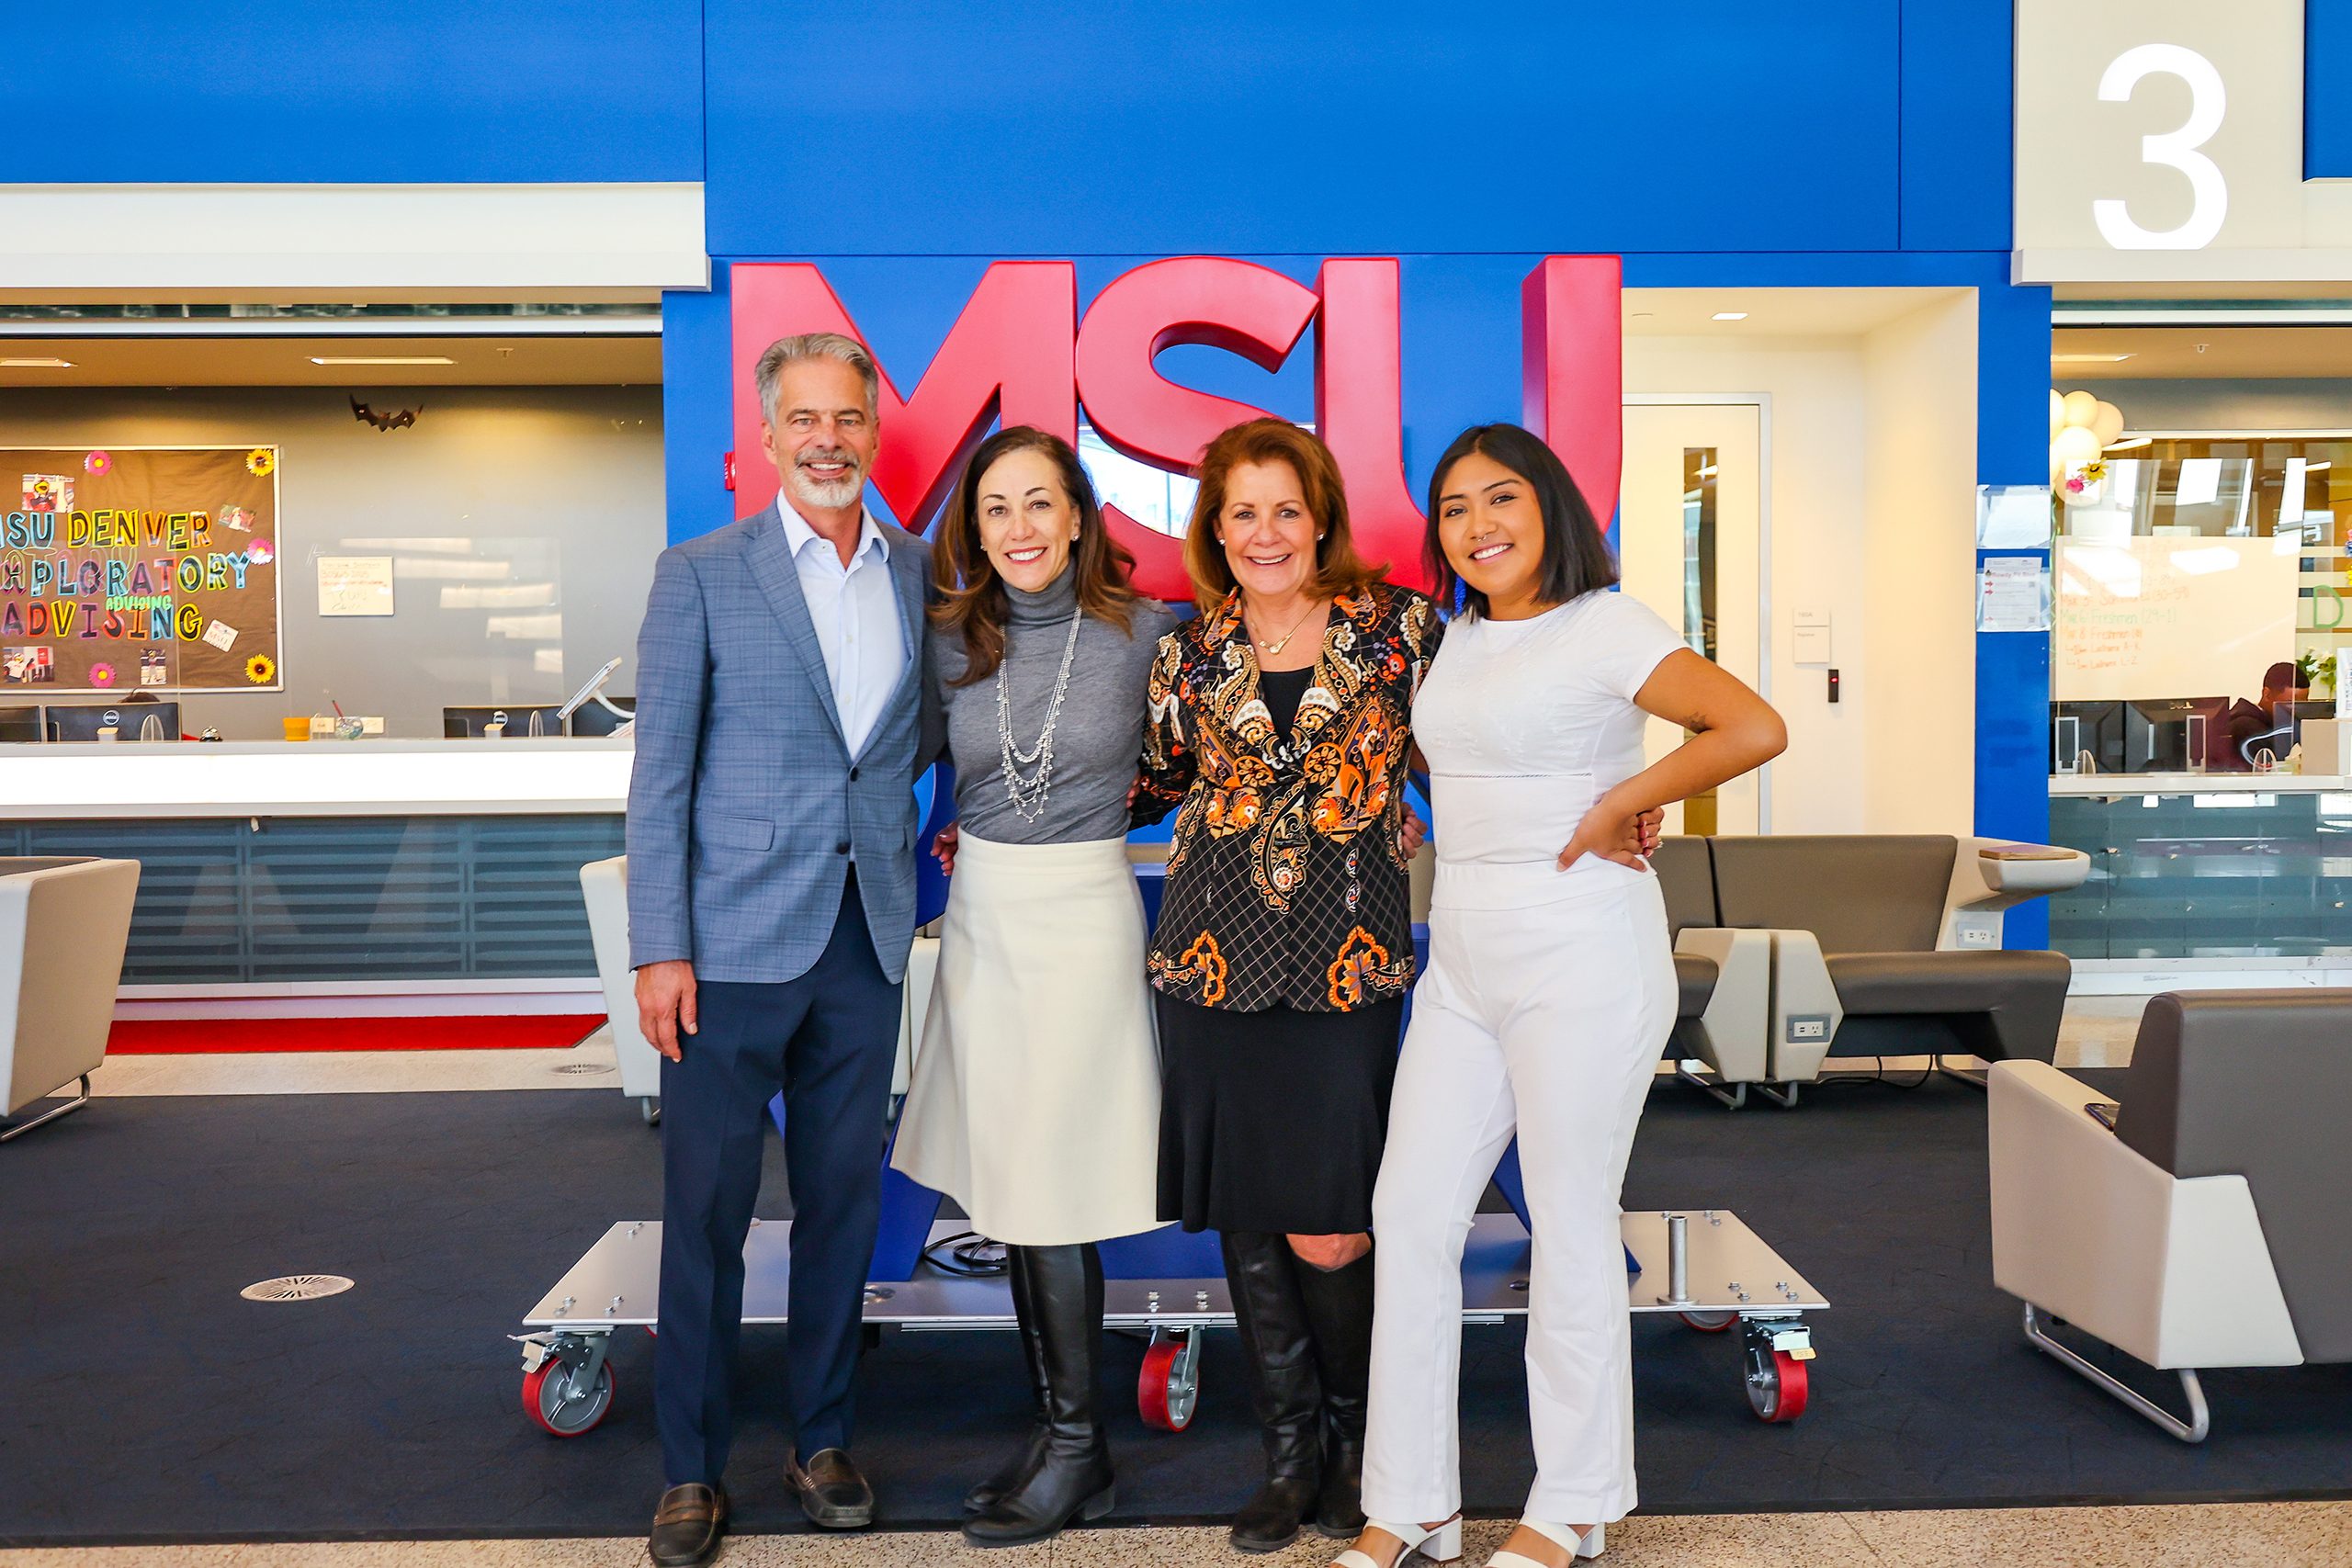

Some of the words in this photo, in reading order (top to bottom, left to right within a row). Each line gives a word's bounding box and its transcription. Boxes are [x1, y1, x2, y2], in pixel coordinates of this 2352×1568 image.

[2093, 43, 2228, 250] 3
[732, 254, 1623, 601] MSU
[0, 512, 55, 549] SU
[67, 509, 213, 551] DENVER
[1, 600, 203, 641] ADVISING
[106, 595, 173, 611] ADVISING
[2091, 608, 2139, 625] Freshmen
[2313, 584, 2343, 628] D
